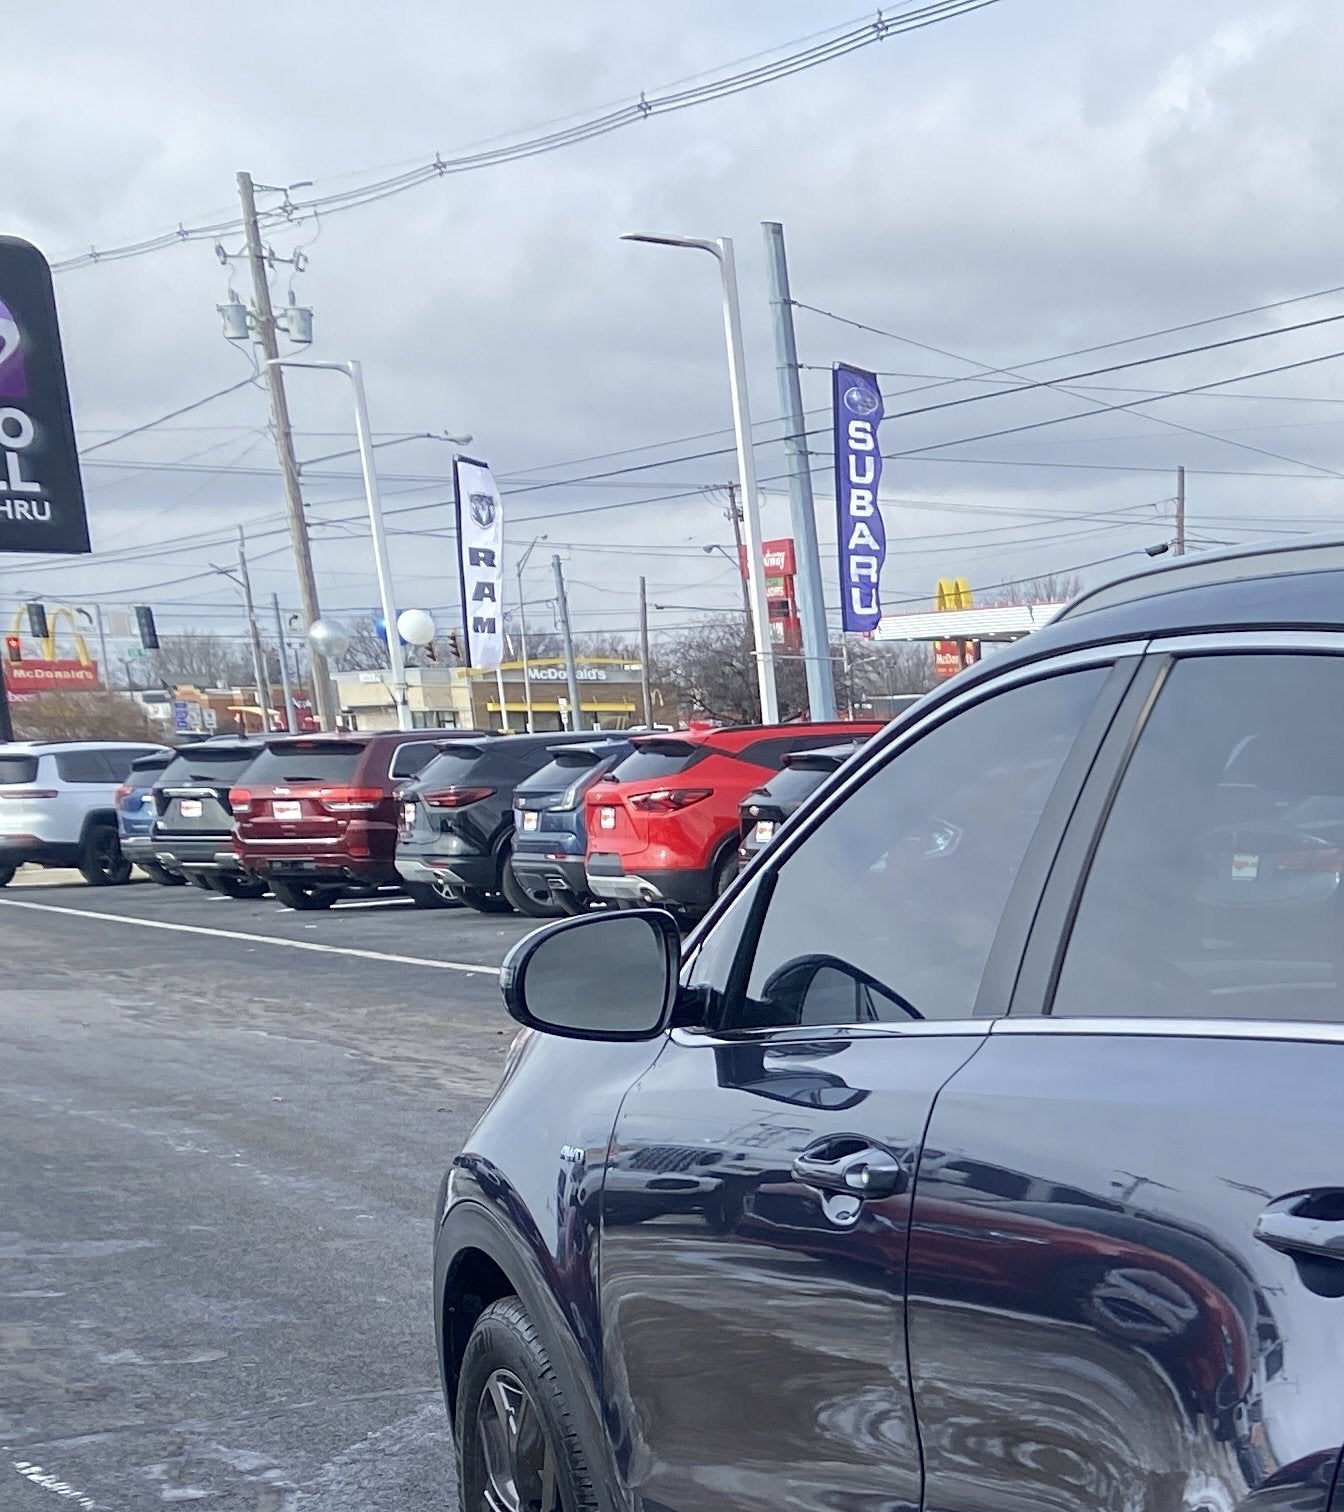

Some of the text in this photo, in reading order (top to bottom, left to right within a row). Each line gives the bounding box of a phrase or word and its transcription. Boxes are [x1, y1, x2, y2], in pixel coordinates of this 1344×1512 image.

[848, 420, 881, 615] SUBARU
[468, 547, 497, 634] RAM
[13, 669, 94, 680] McDonald's
[528, 668, 607, 680] McDoald's
